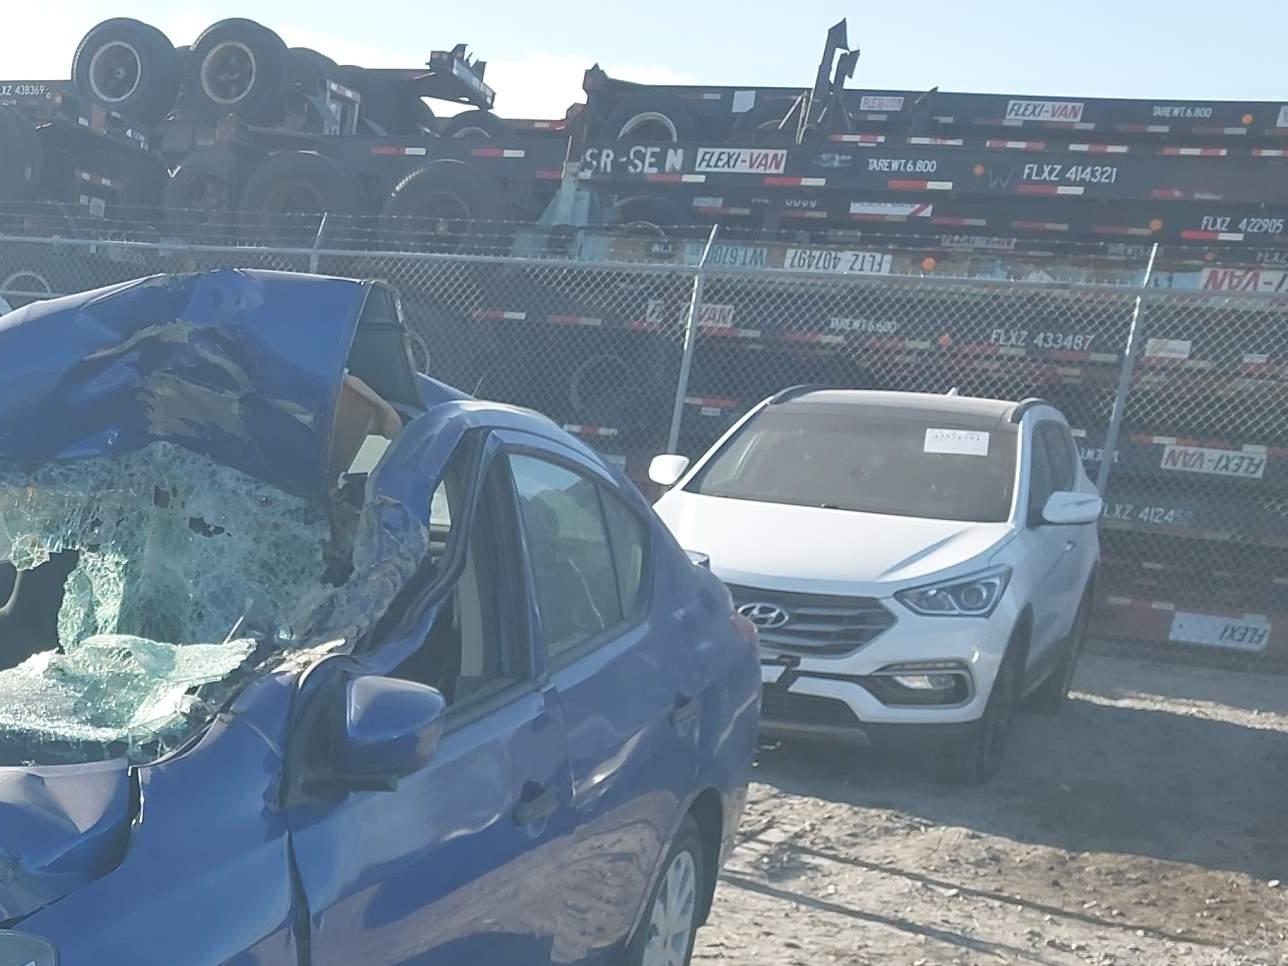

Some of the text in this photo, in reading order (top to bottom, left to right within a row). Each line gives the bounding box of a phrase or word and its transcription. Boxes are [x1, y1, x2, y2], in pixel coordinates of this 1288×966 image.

[15, 86, 45, 97] 438369
[1009, 102, 1081, 119] FLEXI-VAN
[697, 150, 785, 171] FLEXI-VAN
[1023, 163, 1118, 184] FLXZ 414321
[1202, 216, 1284, 233] FLXZ 422905
[790, 248, 883, 270] 407497 FLTZ
[991, 330, 1094, 351] FLXZ 433487
[1165, 450, 1263, 475] FLEXI-VAN
[1102, 505, 1133, 519] LXZ
[1219, 623, 1267, 645] FLEXI
